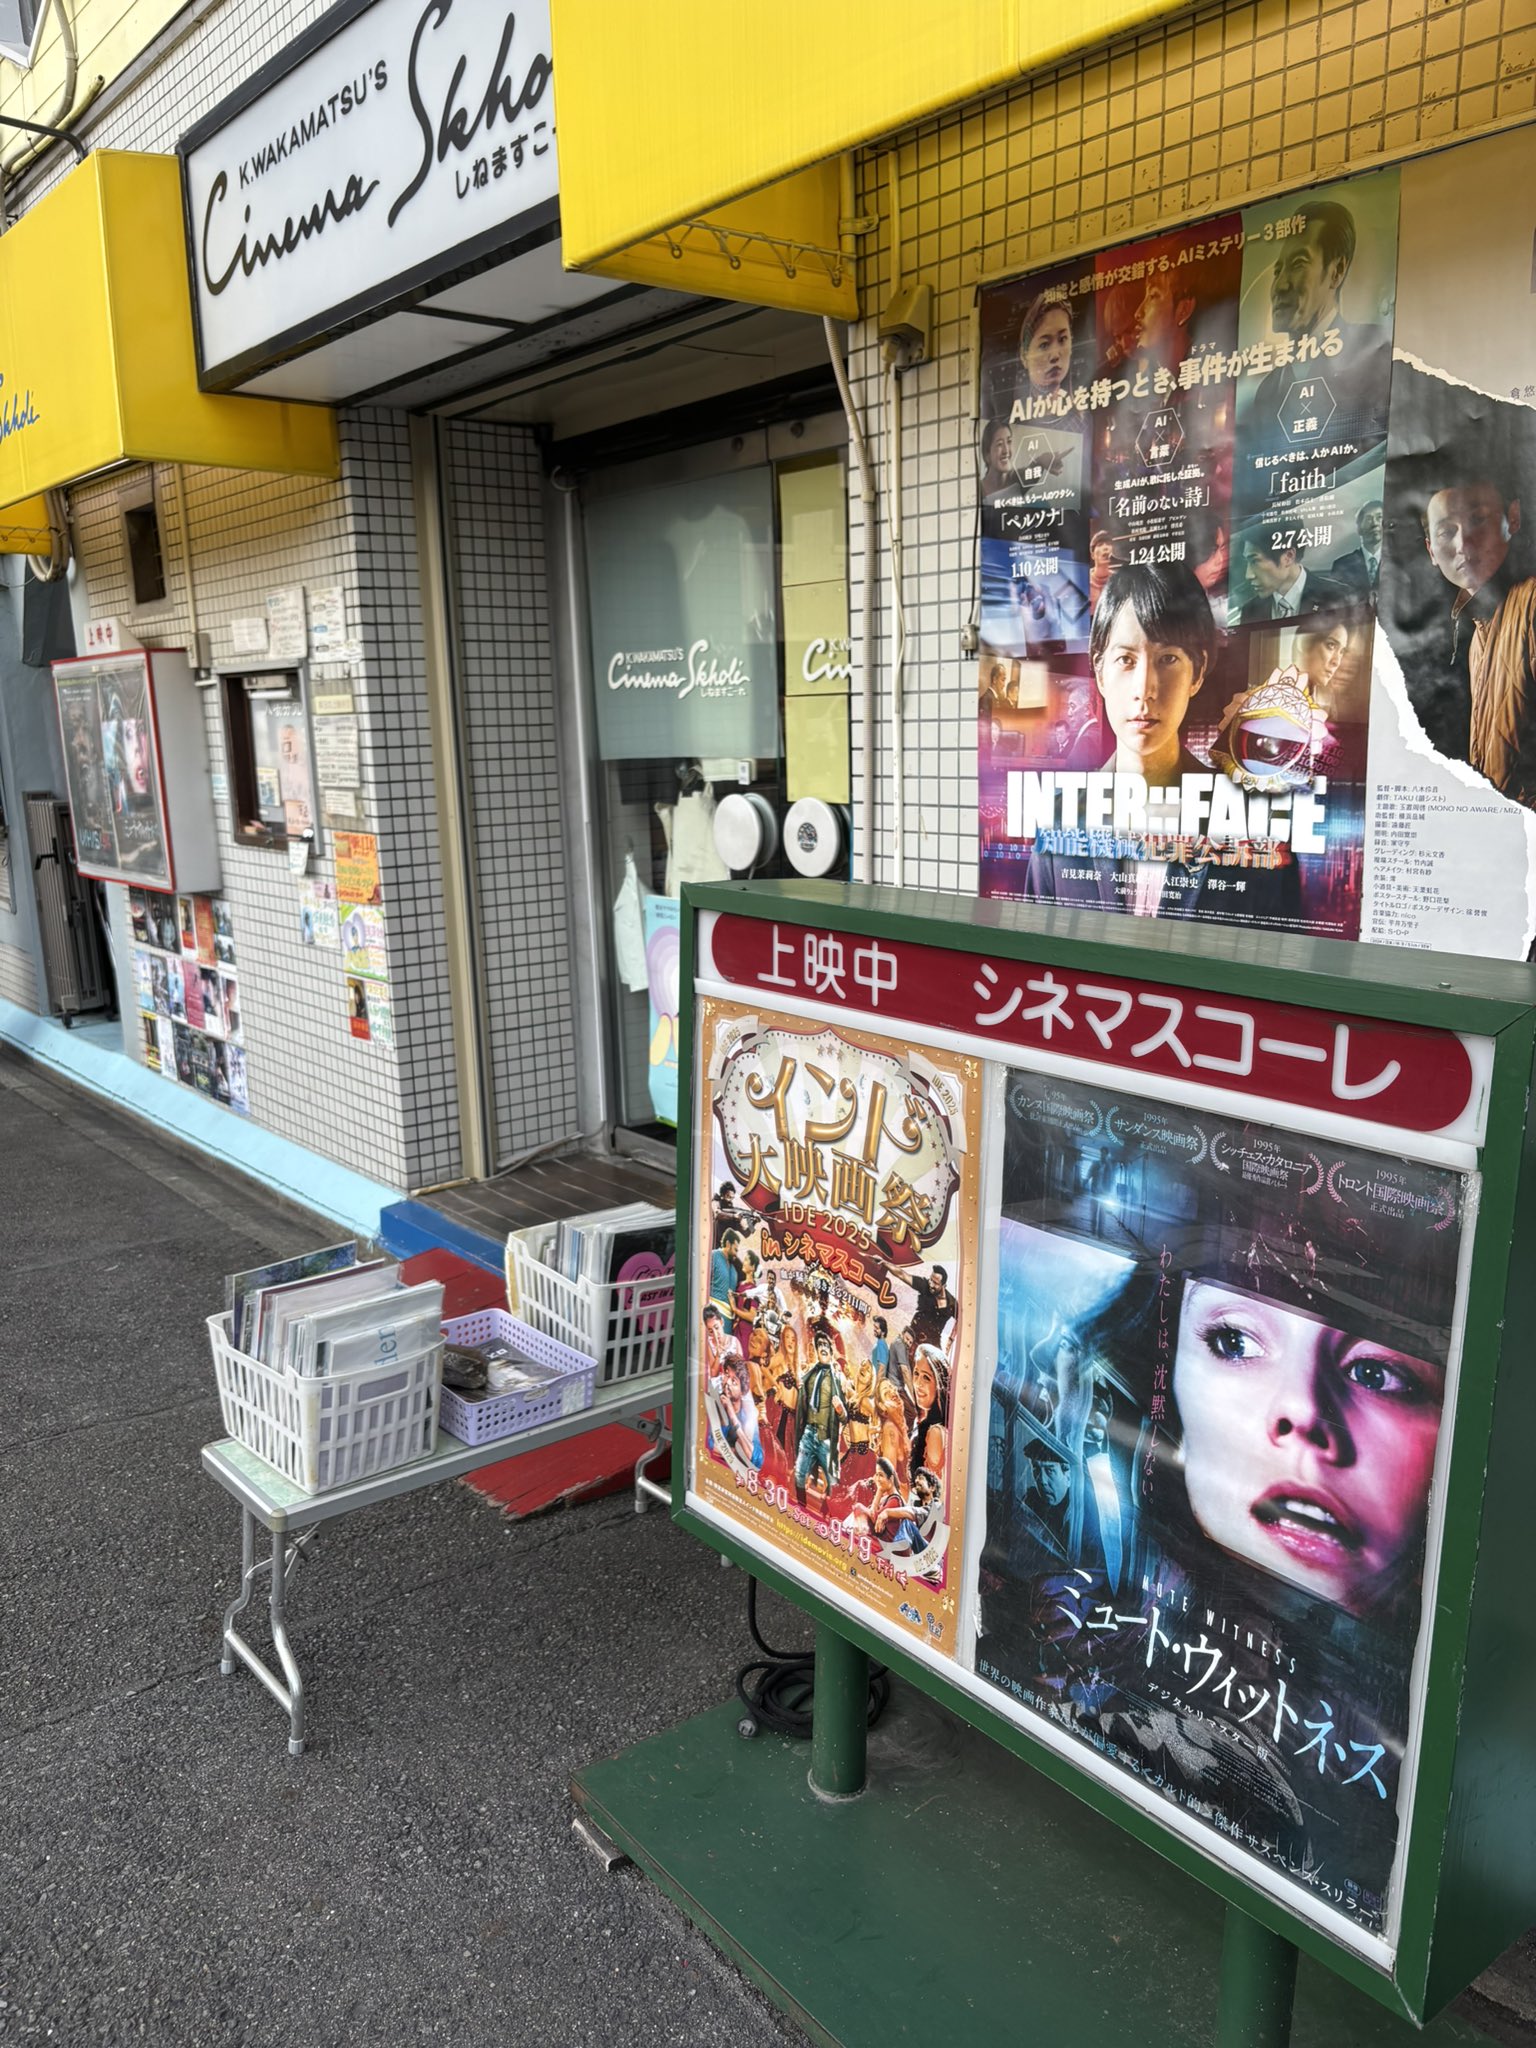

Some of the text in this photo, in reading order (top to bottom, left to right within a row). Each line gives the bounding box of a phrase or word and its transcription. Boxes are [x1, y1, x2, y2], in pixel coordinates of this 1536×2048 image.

[239, 59, 389, 191] K.WAKAMATSU'S
[203, 171, 380, 296] Cinema
[1009, 328, 1344, 424] AIが心を持つとき、事件が生まれる
[1299, 385, 1314, 399] AI
[1155, 415, 1167, 428] AI
[1293, 417, 1318, 433] 正義
[1028, 440, 1039, 451] AI
[1025, 466, 1042, 481] 自我
[1128, 542, 1185, 566] 1.24公開
[1271, 525, 1332, 550] 2.7公開
[1011, 557, 1058, 578] 1.10公開
[607, 652, 685, 690] Cinema
[757, 924, 1401, 1099] 上映中 シネマスコーレ
[745, 1056, 927, 1164] インド
[1114, 1119, 1198, 1151] サンダンス映画祭
[1253, 1139, 1281, 1153] 1995年
[737, 1133, 931, 1252] 大映画祭
[1338, 1174, 1444, 1216] トロント国際映画祭
[1375, 1169, 1406, 1185] 1995年
[784, 1202, 872, 1250] IDE 2025
[761, 1229, 780, 1258] in
[784, 1231, 897, 1307] シネマスコーレ
[1143, 1244, 1175, 1504] わたしは、沈黙しない。
[1142, 1574, 1296, 1675] MUTE WITNESS
[1056, 1568, 1388, 1800] ミュート・ウィットネス
[1147, 1682, 1270, 1762] デジタルリマスター版
